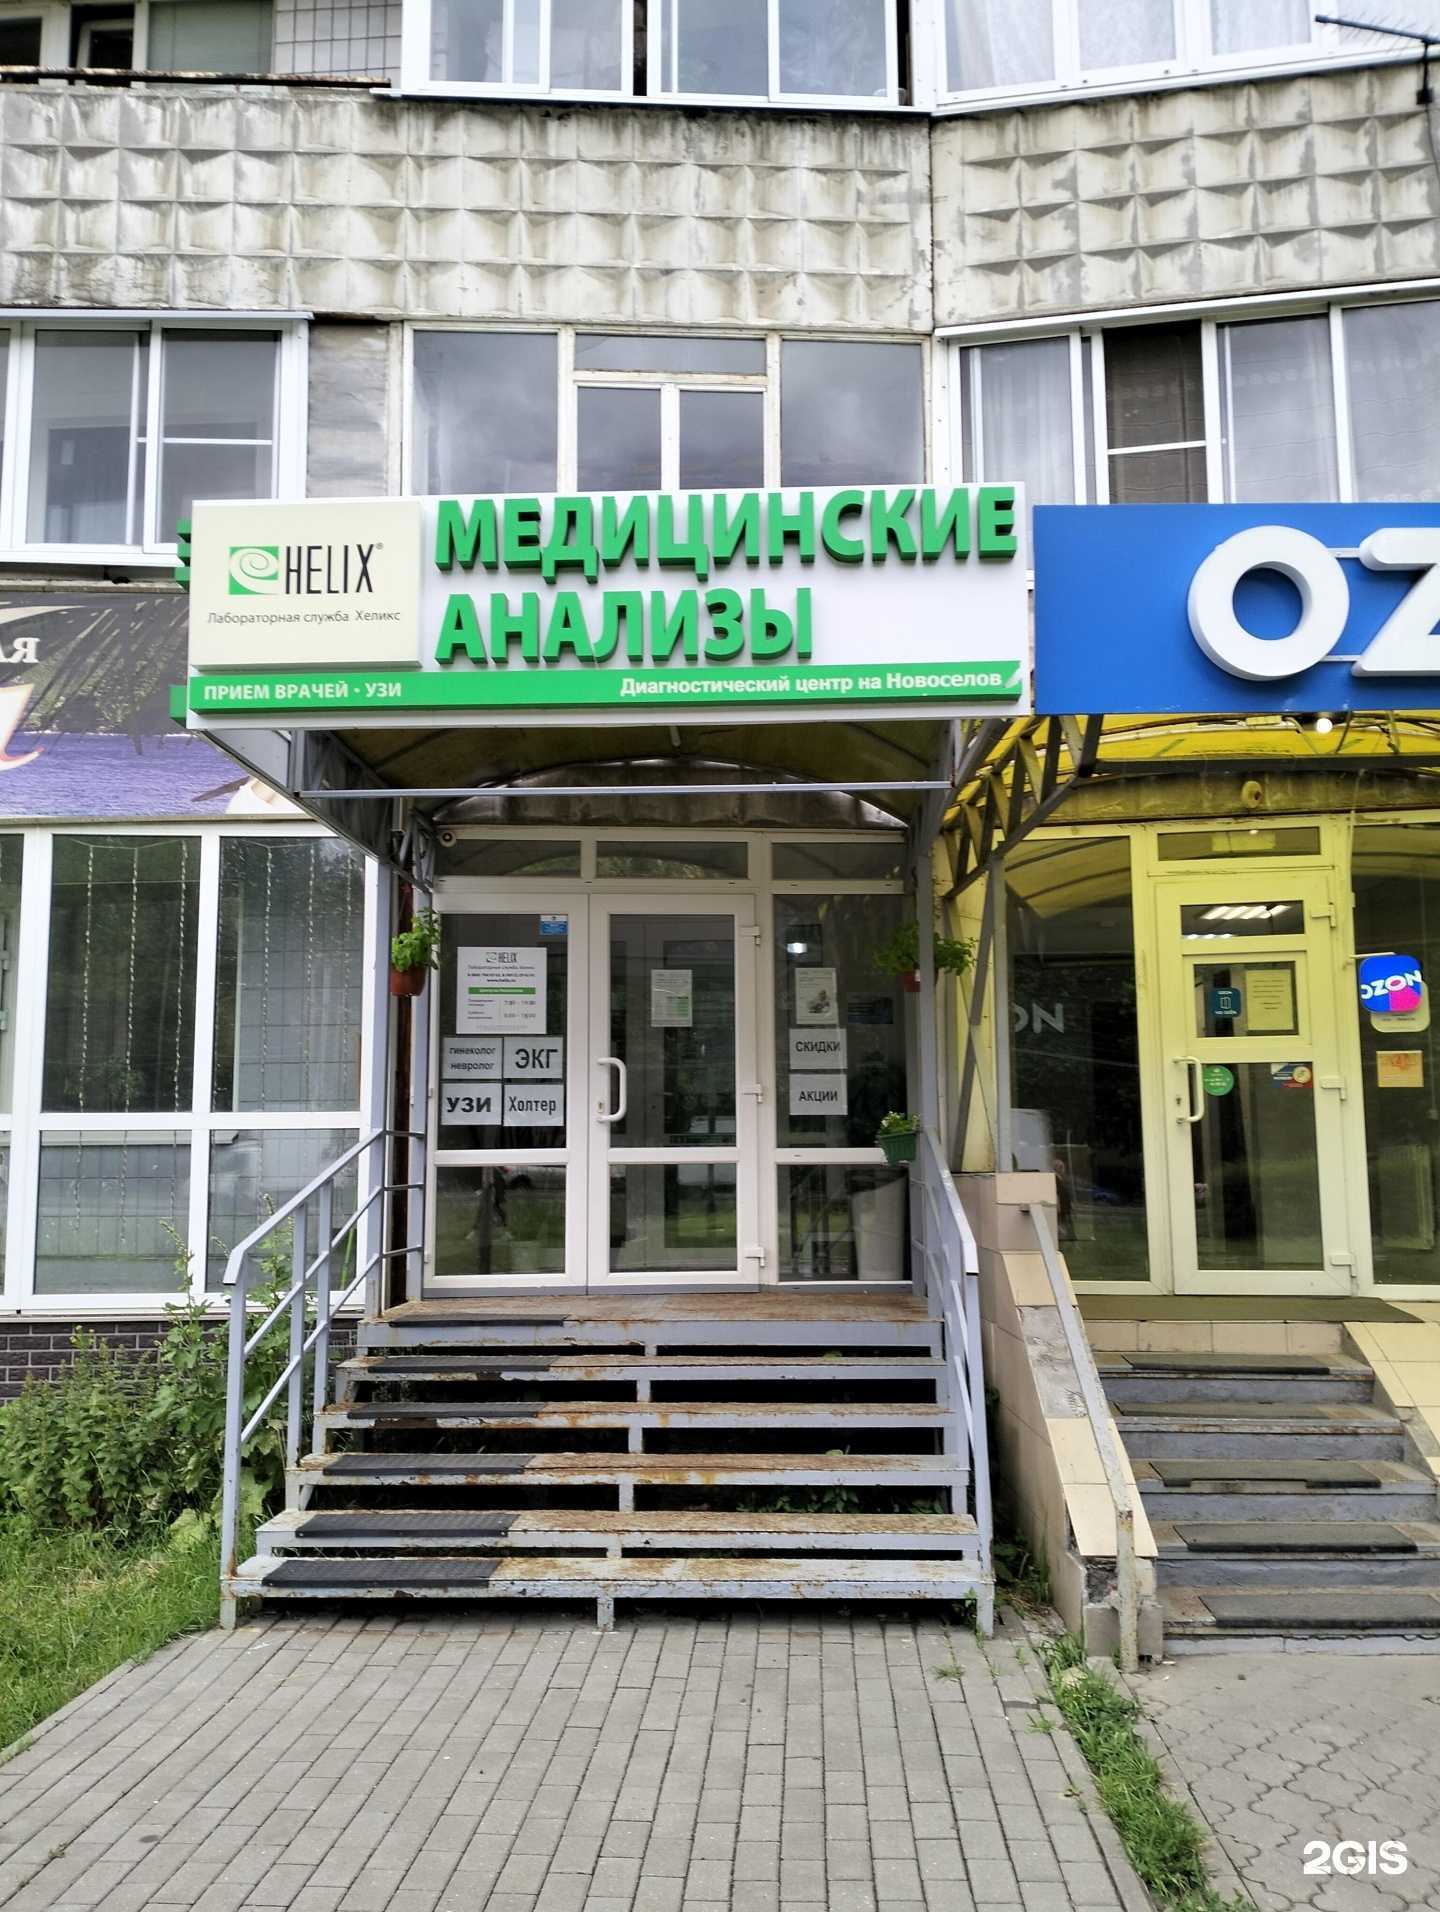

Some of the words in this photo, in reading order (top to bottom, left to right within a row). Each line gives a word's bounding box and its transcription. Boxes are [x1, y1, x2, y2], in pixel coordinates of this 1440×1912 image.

[434, 486, 1018, 584] МЕДИЦИНСКИЕ
[207, 612, 300, 626] Лабораторная
[303, 610, 350, 625] служба
[354, 609, 402, 622] Хеликс
[434, 586, 813, 665] АНАЛИЗЫ
[203, 684, 270, 701] ПРИЕМ
[274, 680, 349, 700] ВРАЧЕЙ
[364, 682, 402, 699] УЗИ
[619, 675, 789, 697] Диагностический
[795, 676, 851, 695] центр
[858, 676, 882, 690] на
[886, 671, 1003, 690] Новоселов
[795, 1041, 840, 1053] СКИДКИ
[450, 1062, 494, 1071] невролог
[515, 1048, 558, 1069] ЭКГ
[446, 1097, 492, 1113] УЗИ
[508, 1096, 556, 1115] Холтер
[799, 1090, 838, 1102] АКЦИИ
